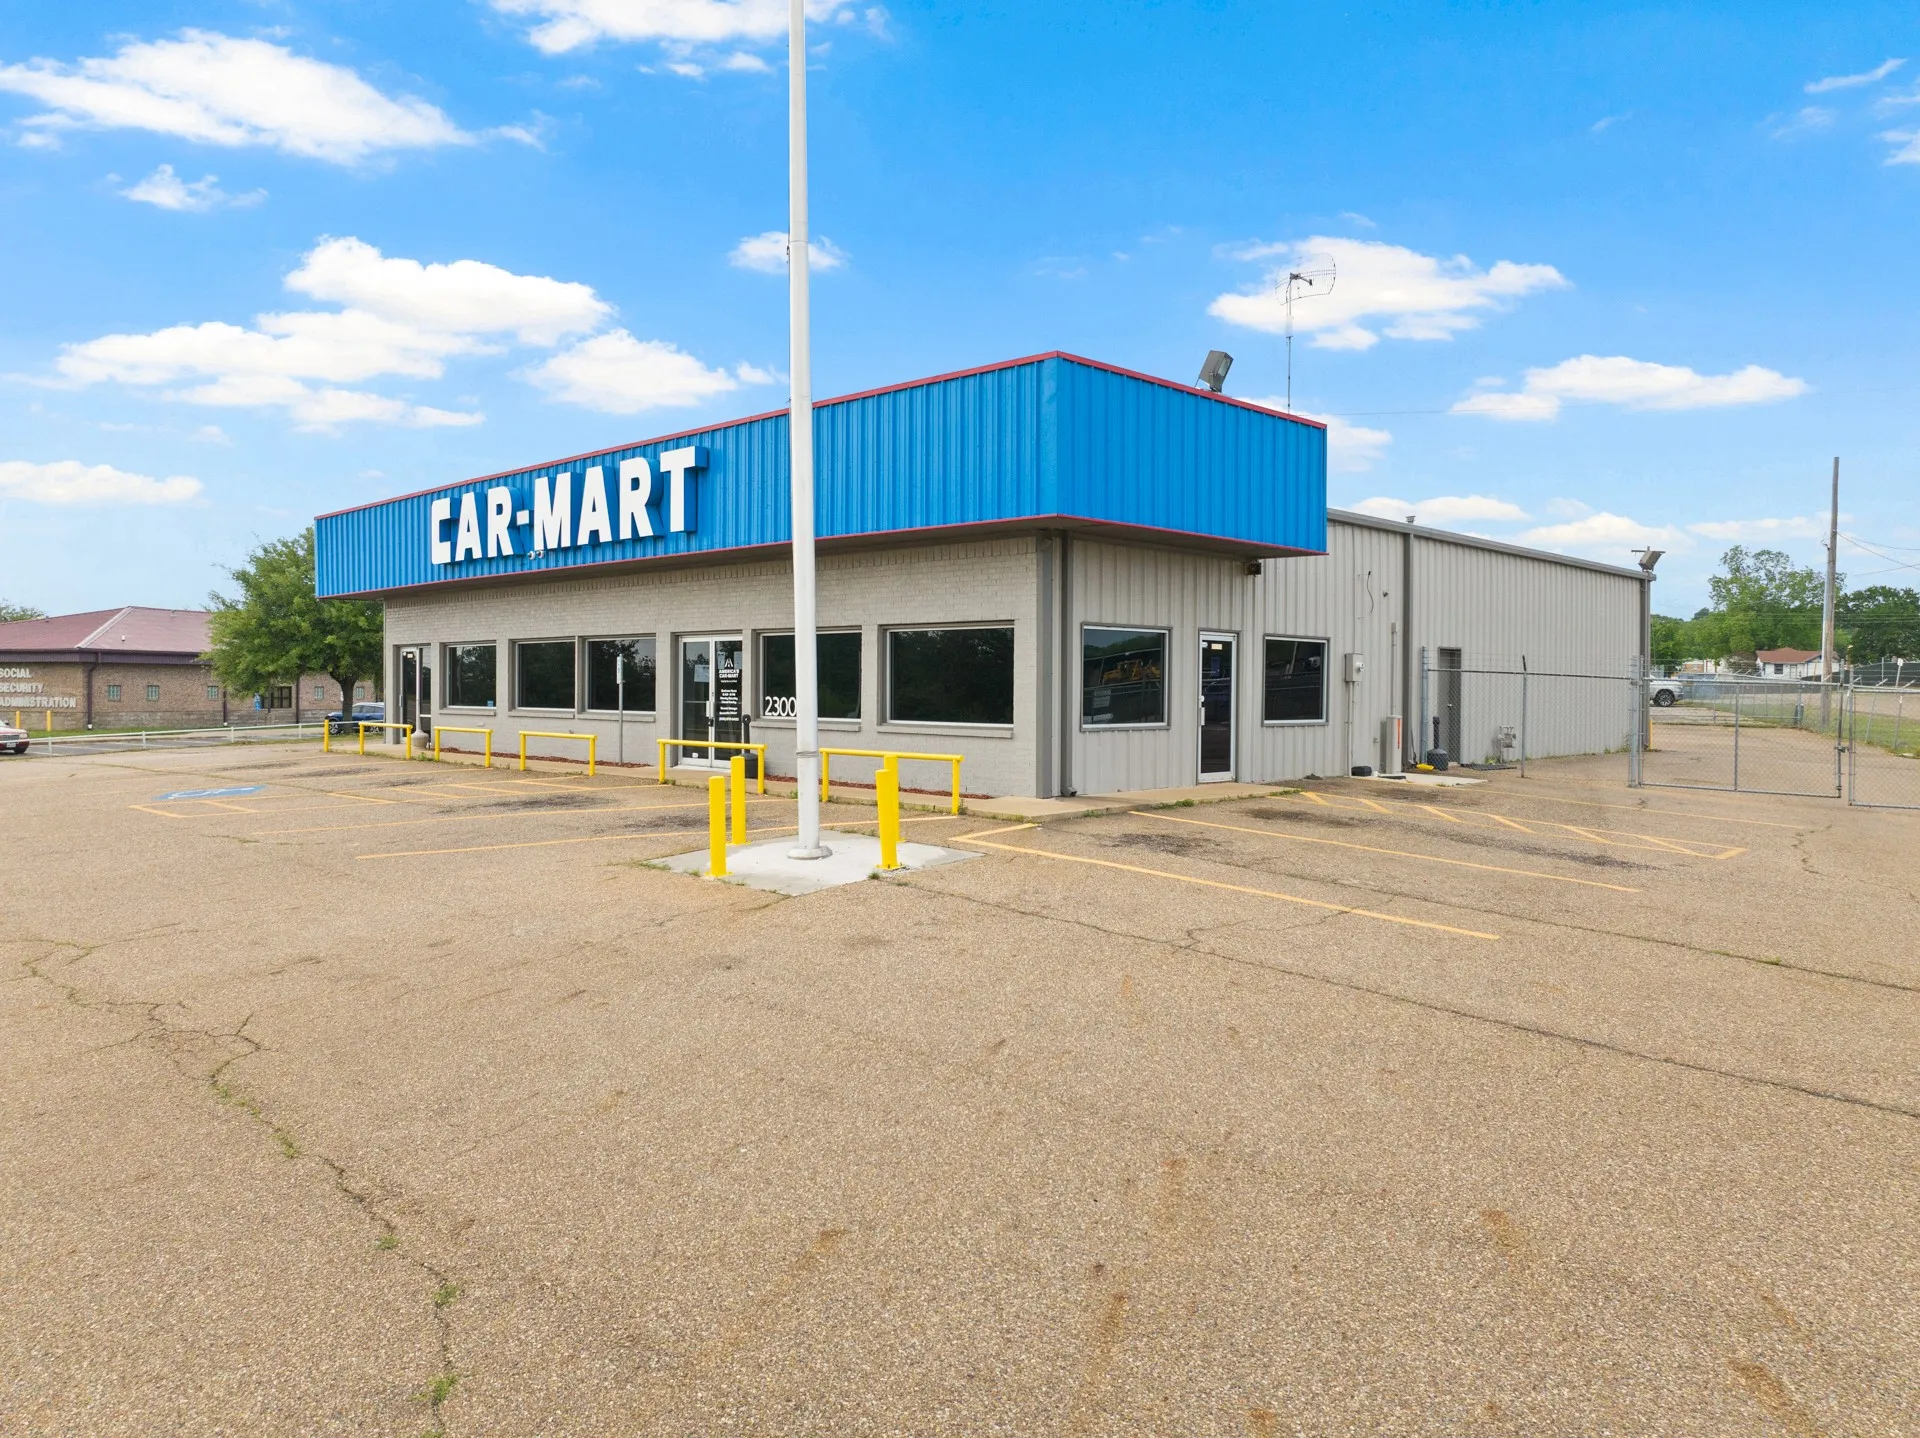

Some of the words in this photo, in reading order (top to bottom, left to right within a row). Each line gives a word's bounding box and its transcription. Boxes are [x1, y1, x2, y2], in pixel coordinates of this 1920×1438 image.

[431, 446, 697, 565] CAR-MART
[0, 668, 32, 678] SOCIAL
[0, 682, 44, 693] SECURITY
[0, 696, 76, 708] ADMINISTRATION
[765, 696, 797, 717] 2300
